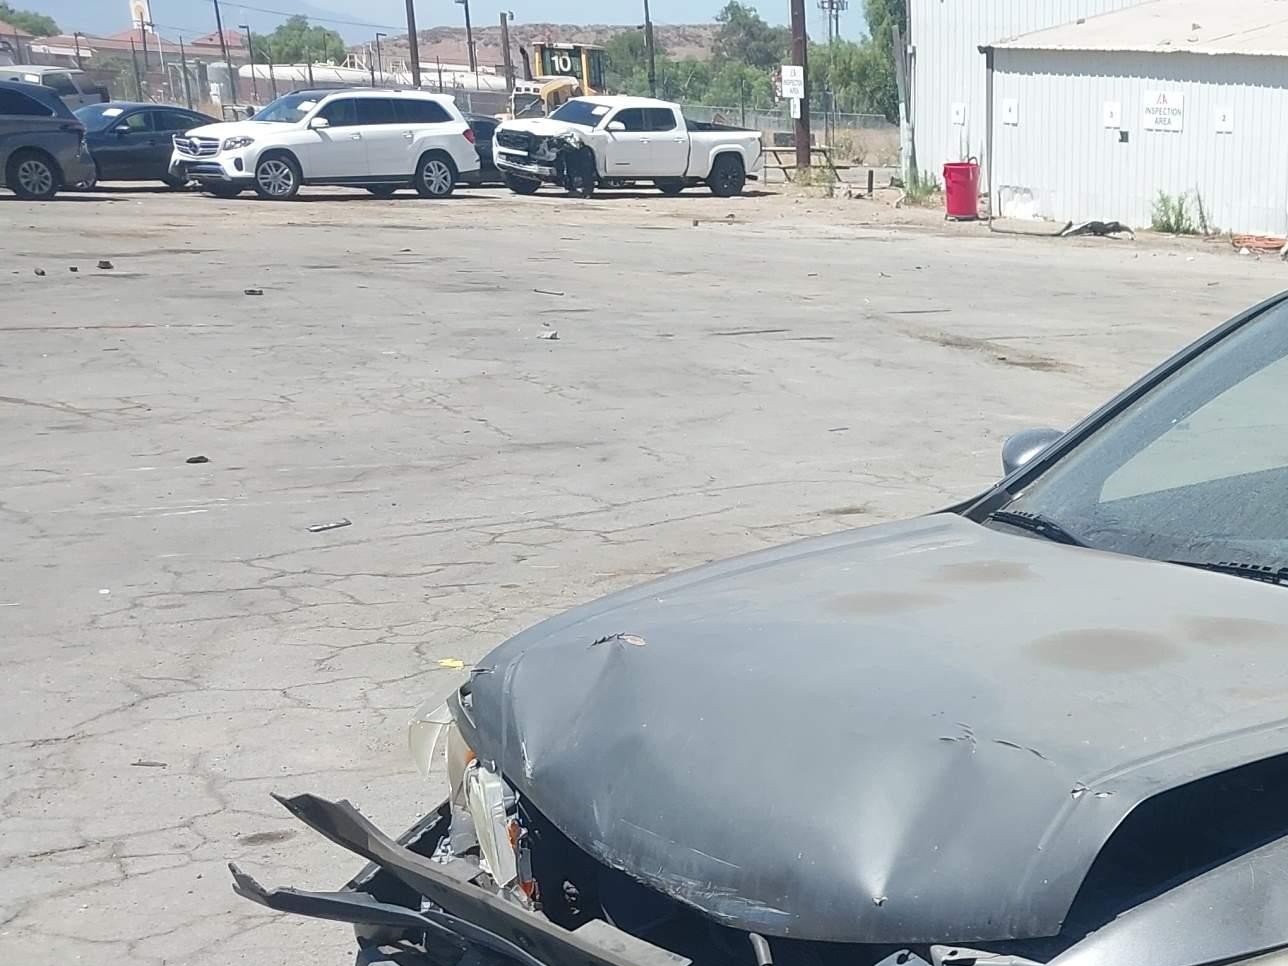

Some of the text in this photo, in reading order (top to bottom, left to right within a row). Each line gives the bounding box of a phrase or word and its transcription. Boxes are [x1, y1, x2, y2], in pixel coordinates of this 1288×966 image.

[551, 55, 572, 74] 10
[1144, 106, 1182, 117] INSPECTION
[1154, 116, 1172, 126] AREA
